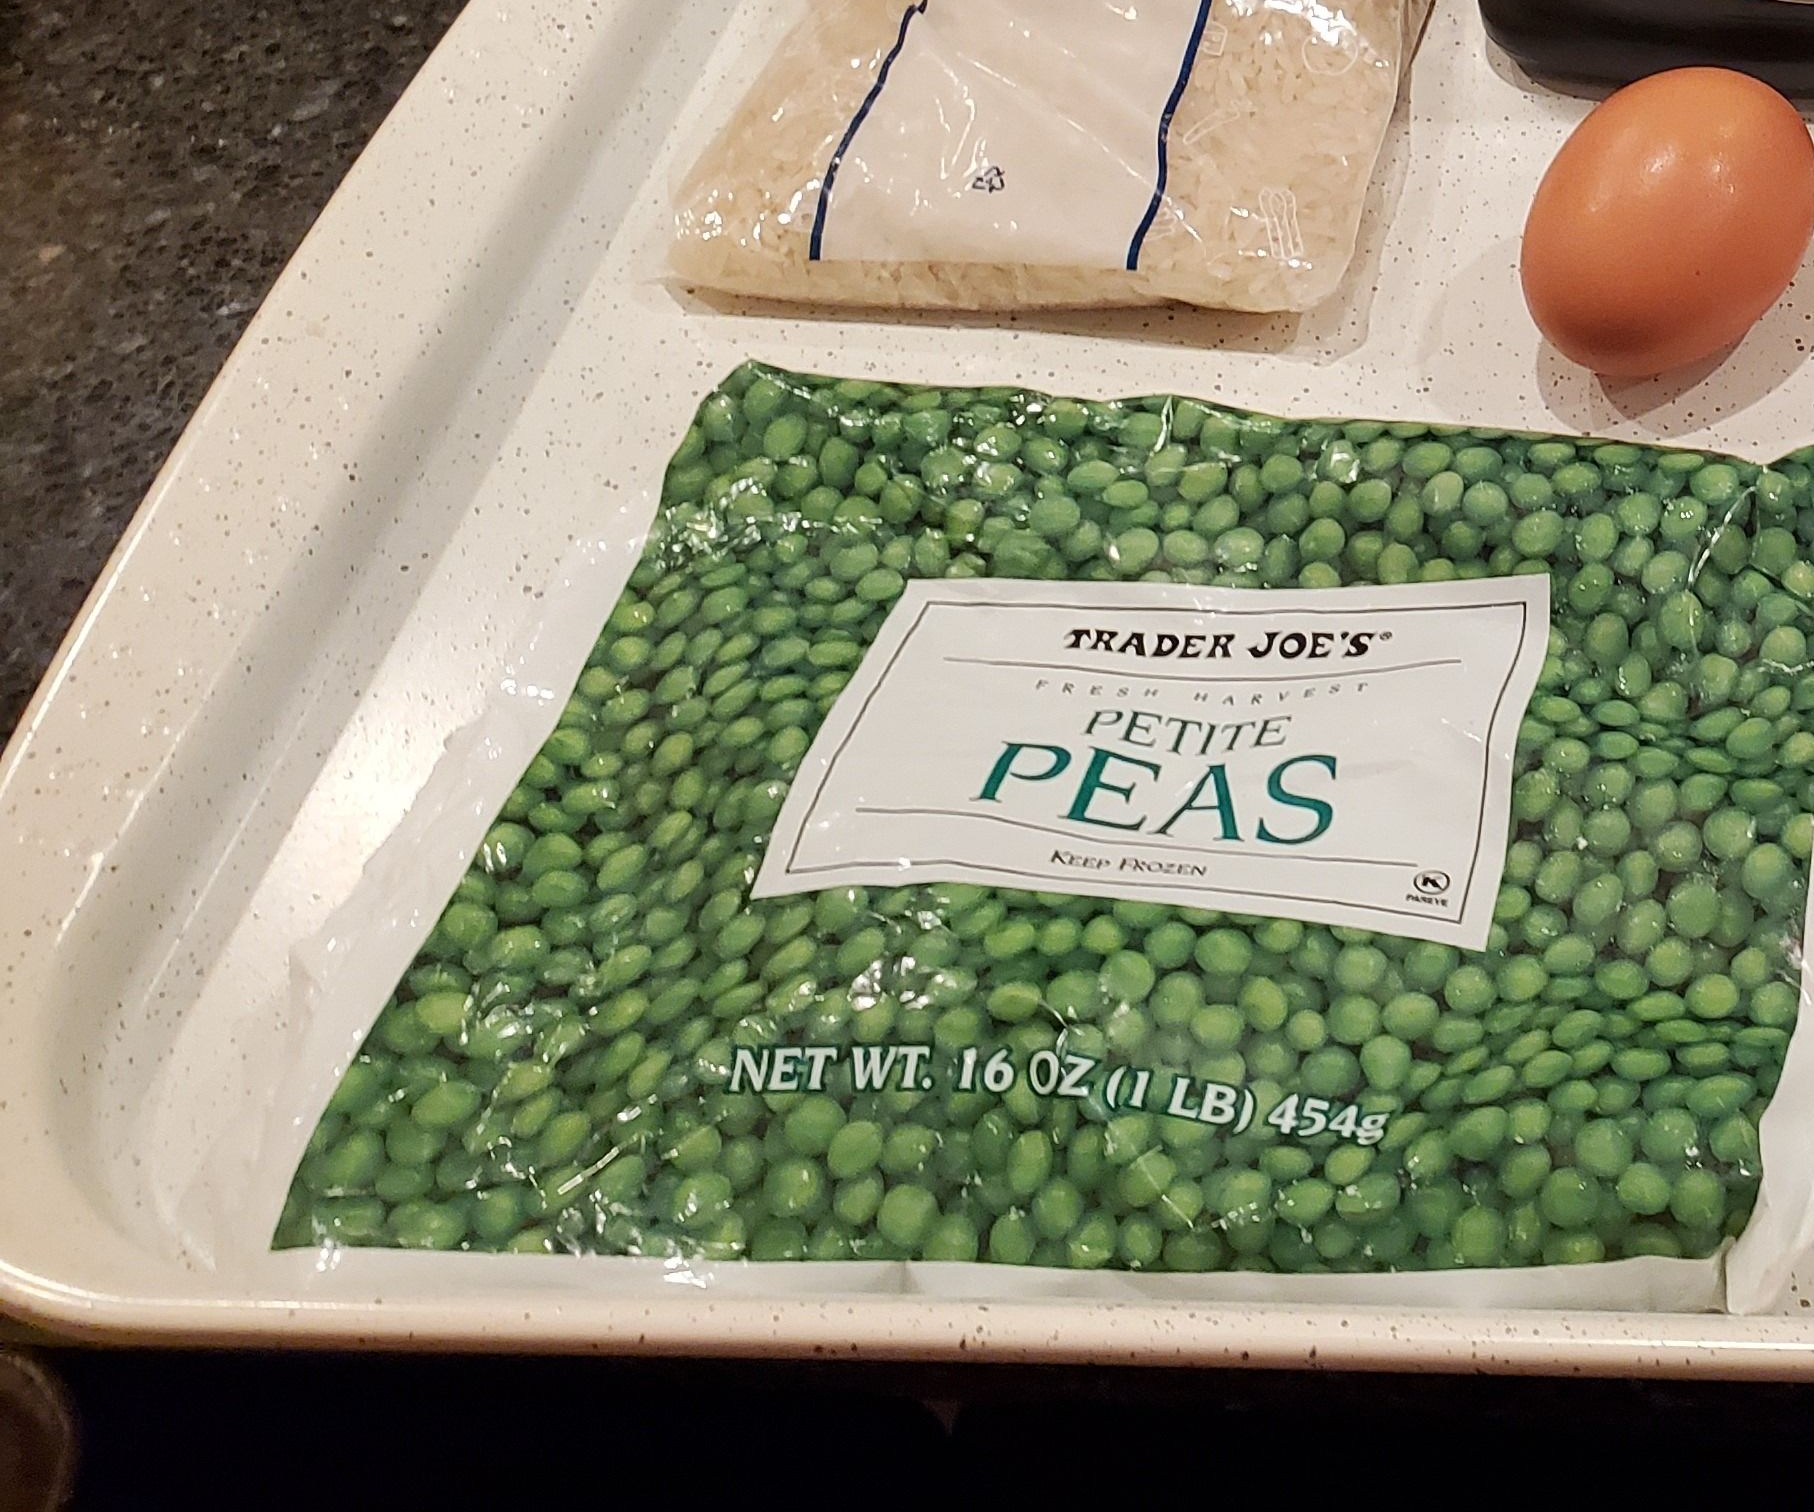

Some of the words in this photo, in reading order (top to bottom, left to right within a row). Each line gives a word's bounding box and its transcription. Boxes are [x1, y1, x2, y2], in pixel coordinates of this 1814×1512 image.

[1064, 628, 1236, 659] TRADER
[1035, 679, 1159, 699] FRESH
[1193, 682, 1369, 706] HARVEST
[1081, 709, 1293, 756] PETITE
[968, 740, 1338, 845] PEAS
[728, 1046, 836, 1092] NET
[849, 1046, 933, 1090] WT.
[956, 1048, 1013, 1092] 16
[1029, 1049, 1100, 1098] OZ
[1104, 1065, 1149, 1109] (1
[1167, 1077, 1255, 1134] LB)
[1267, 1093, 1393, 1146] 454g
